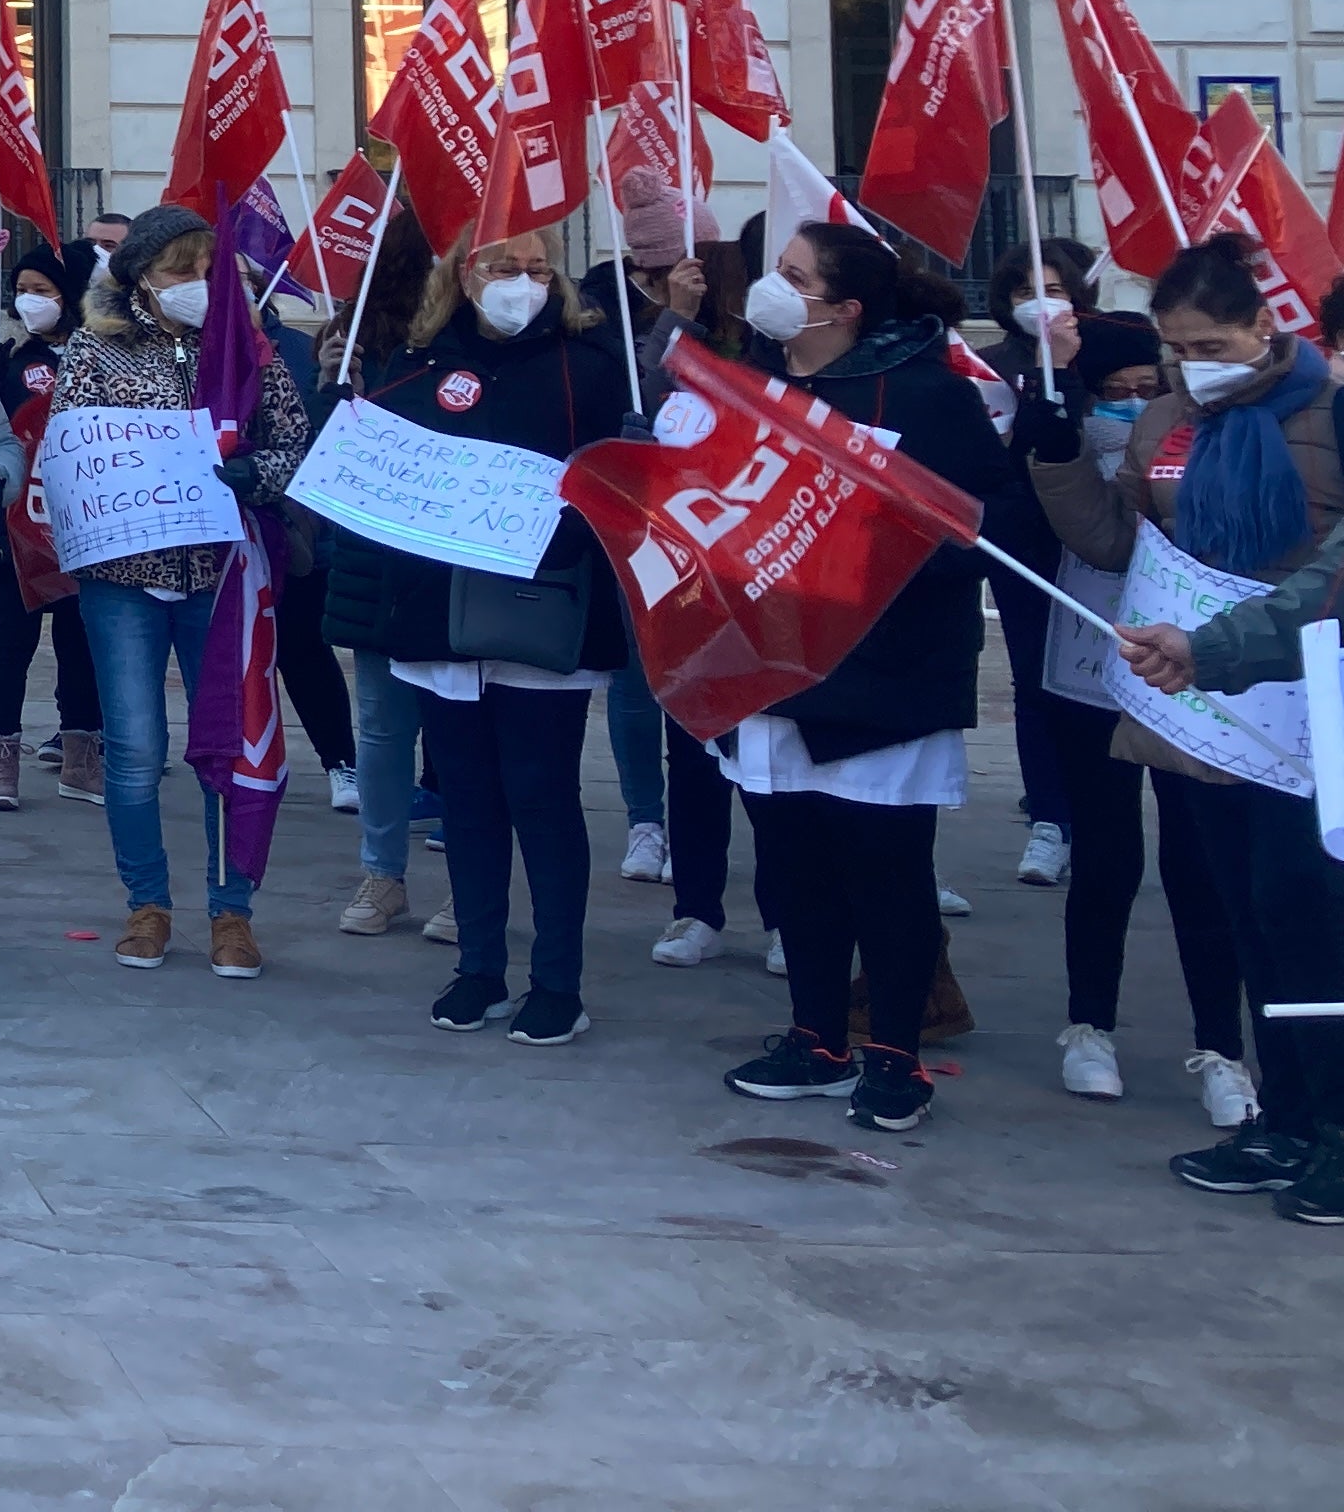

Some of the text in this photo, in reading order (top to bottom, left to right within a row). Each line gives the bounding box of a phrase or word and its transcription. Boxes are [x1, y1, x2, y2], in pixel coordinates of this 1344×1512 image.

[406, 48, 460, 127] omisiones
[445, 373, 481, 400] UGT
[60, 419, 180, 454] CUIDADO
[355, 417, 479, 467] SALARIO
[75, 450, 145, 482] NO ES
[334, 440, 557, 504] CONVENIO JUSTO
[82, 483, 203, 523] NEGOCIO
[334, 464, 456, 520] RECORTES
